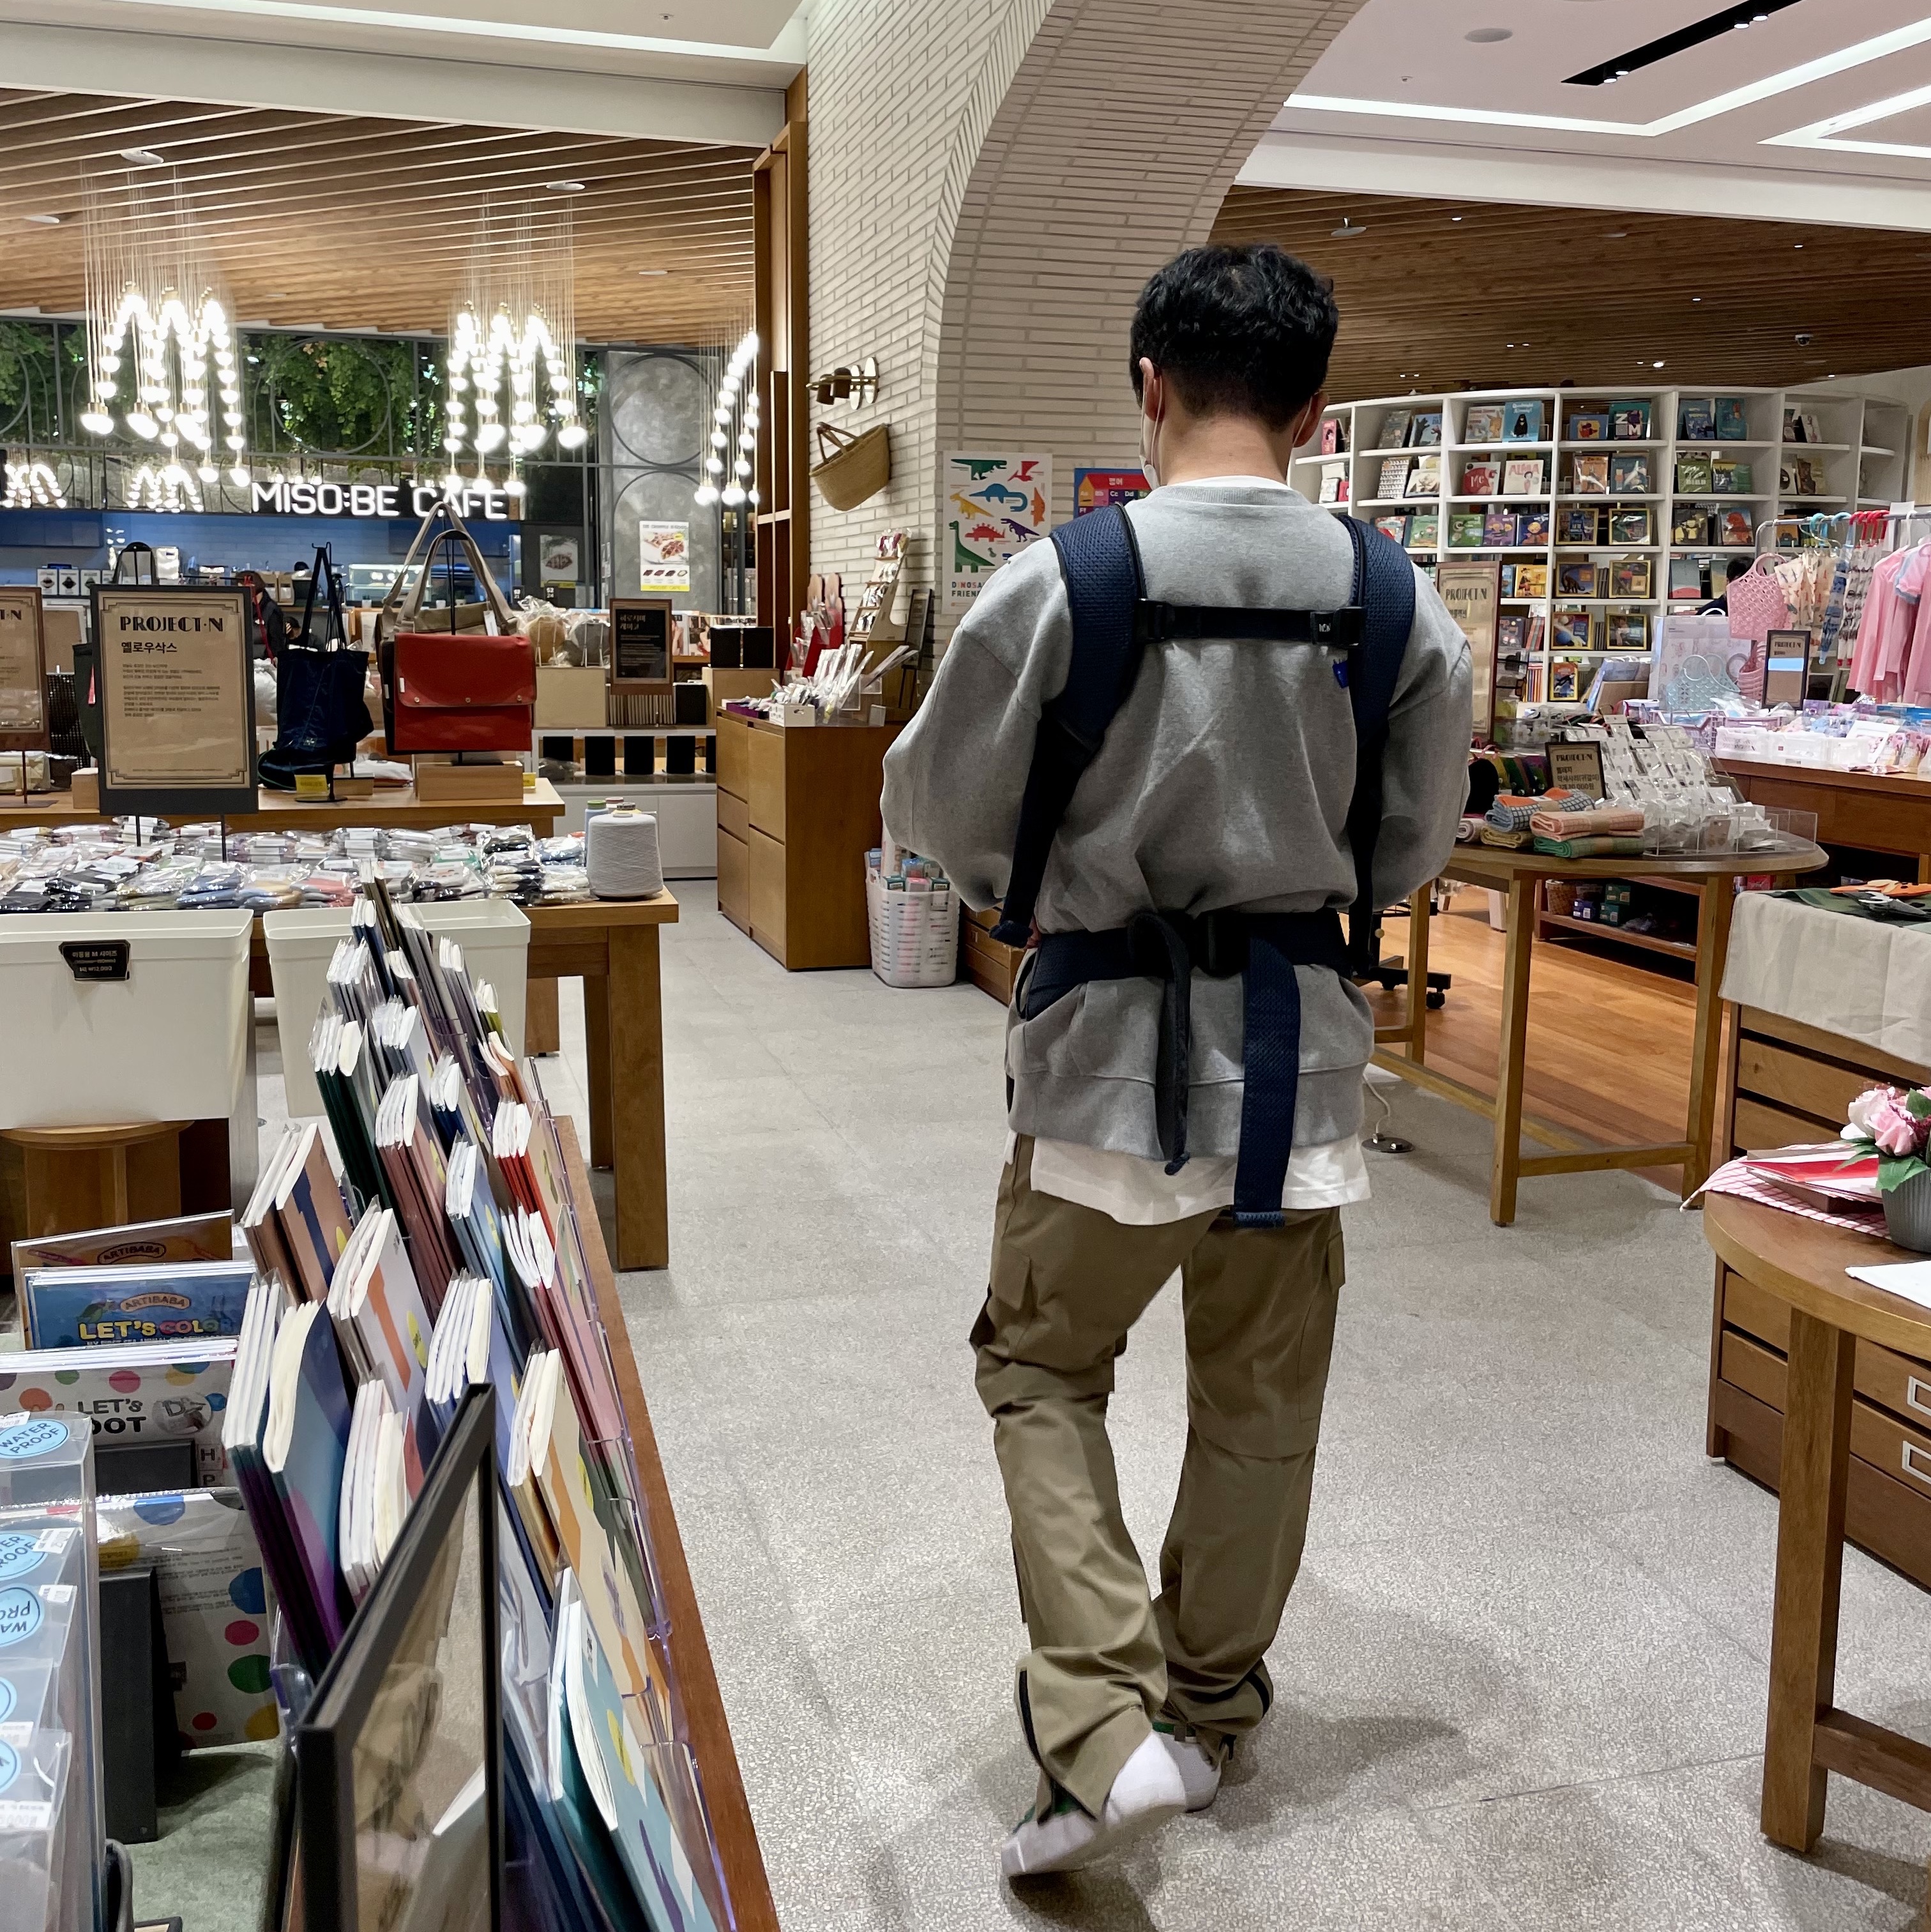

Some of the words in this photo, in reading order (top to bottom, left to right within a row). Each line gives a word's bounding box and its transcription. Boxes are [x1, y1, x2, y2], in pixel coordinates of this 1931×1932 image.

[413, 487, 507, 520] CAFE
[103, 1245, 160, 1261] ARTIBABA
[125, 1296, 185, 1309] ARTIBABA
[79, 1320, 156, 1340] LET'S
[77, 1398, 143, 1414] LET'S
[0, 1422, 51, 1448] WATER
[10, 1427, 59, 1454] PROOF
[0, 1541, 35, 1568] ROOF
